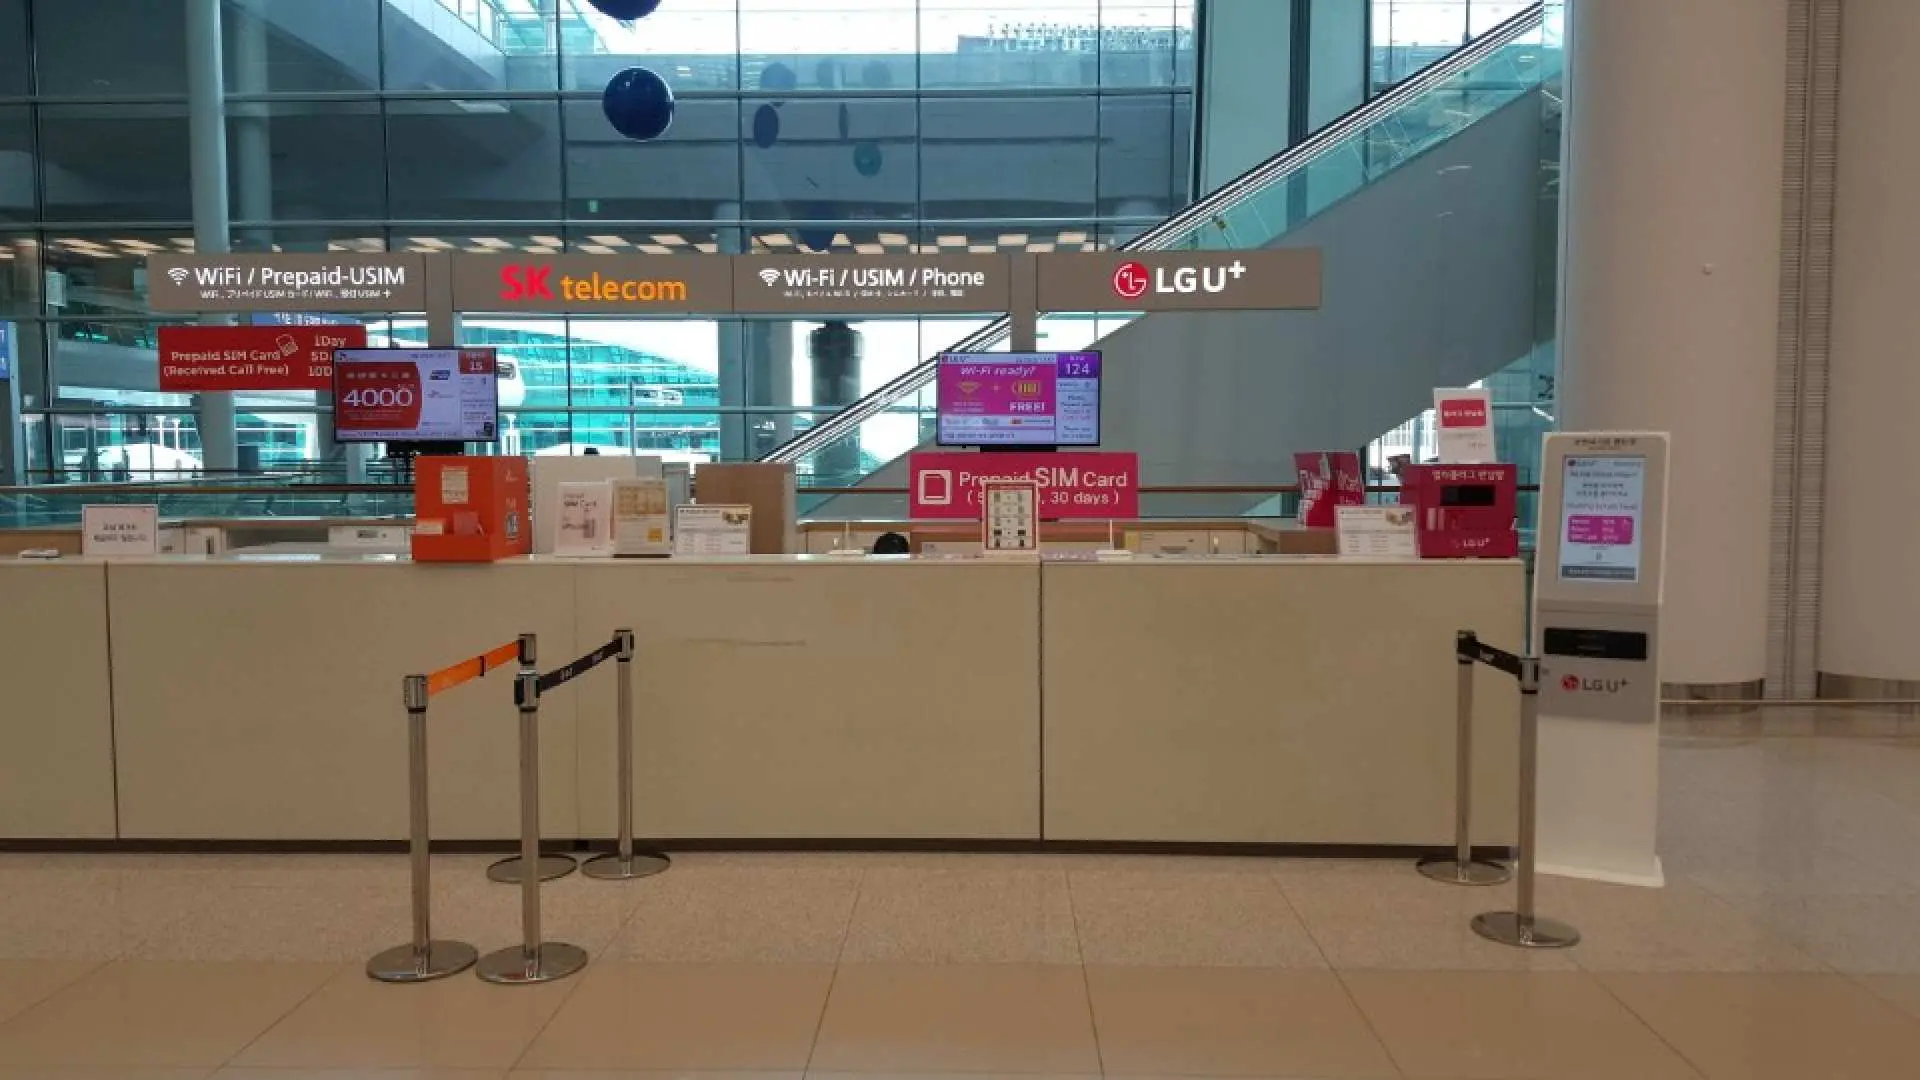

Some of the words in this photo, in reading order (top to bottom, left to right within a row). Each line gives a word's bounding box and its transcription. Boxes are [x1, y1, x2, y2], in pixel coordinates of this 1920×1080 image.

[193, 266, 241, 285] WiFi
[247, 267, 255, 285] /
[261, 266, 405, 290] Prepaid-USIM
[499, 264, 556, 301] SK
[560, 271, 687, 301] telecom
[783, 268, 835, 287] Wi-Fi
[839, 268, 848, 287] /
[853, 268, 904, 287] USIM
[909, 268, 918, 287] /
[922, 268, 985, 287] Phone
[171, 351, 221, 362] Prepaid
[224, 351, 247, 360] SIM
[250, 351, 281, 360] Card
[311, 351, 333, 361] 5D
[163, 365, 225, 377] (Received
[229, 365, 253, 375] Call
[257, 365, 289, 376] Free)
[308, 366, 333, 377] 10D
[960, 366, 991, 375] Wi-Fi
[993, 366, 1036, 378] ready?
[1065, 363, 1090, 375] 124
[343, 388, 413, 407] 4000
[1009, 402, 1045, 411] FREE!
[1035, 467, 1078, 488] SIM
[1083, 471, 1128, 487] Card
[1051, 492, 1069, 504] 30
[1074, 491, 1109, 506] days
[1582, 677, 1603, 691] LG
[1605, 677, 1630, 693] U+
